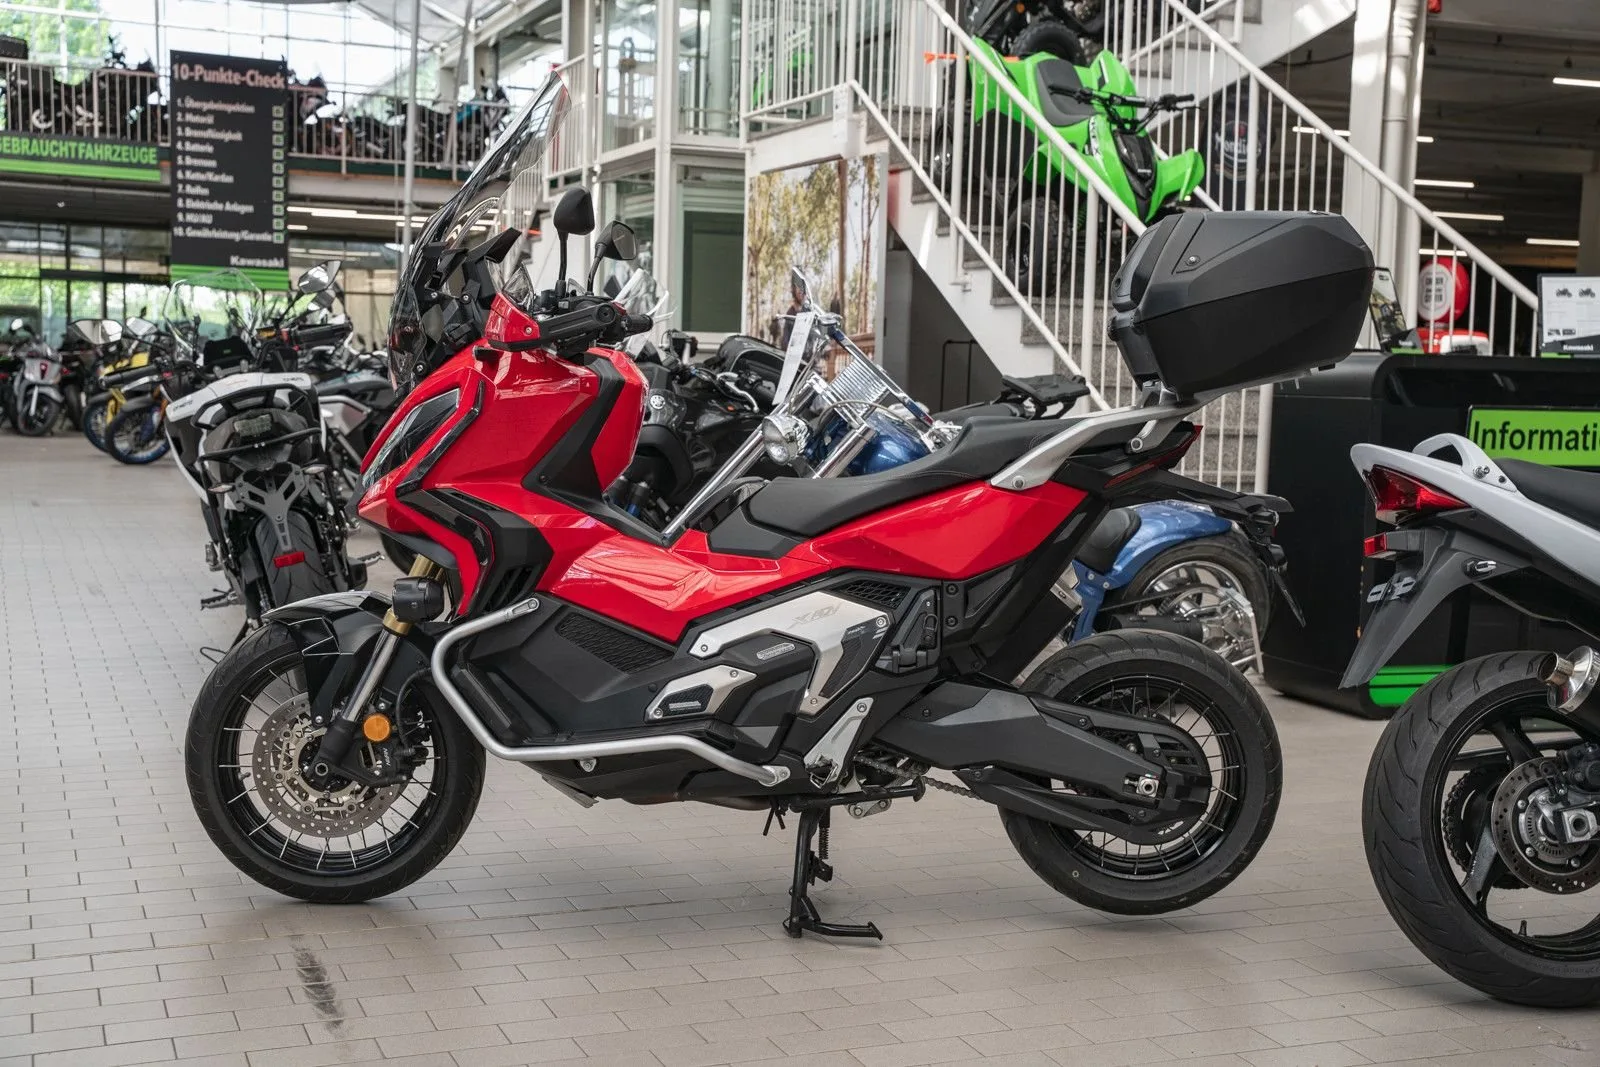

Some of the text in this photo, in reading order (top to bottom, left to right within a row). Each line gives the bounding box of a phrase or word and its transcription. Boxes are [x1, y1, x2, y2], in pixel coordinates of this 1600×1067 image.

[172, 63, 285, 89] 10-Punkte-Check
[0, 136, 158, 164] EBRAUCHTFAHRZEUGE
[230, 255, 285, 269] Kawasaki
[1473, 420, 1600, 452] Informati
